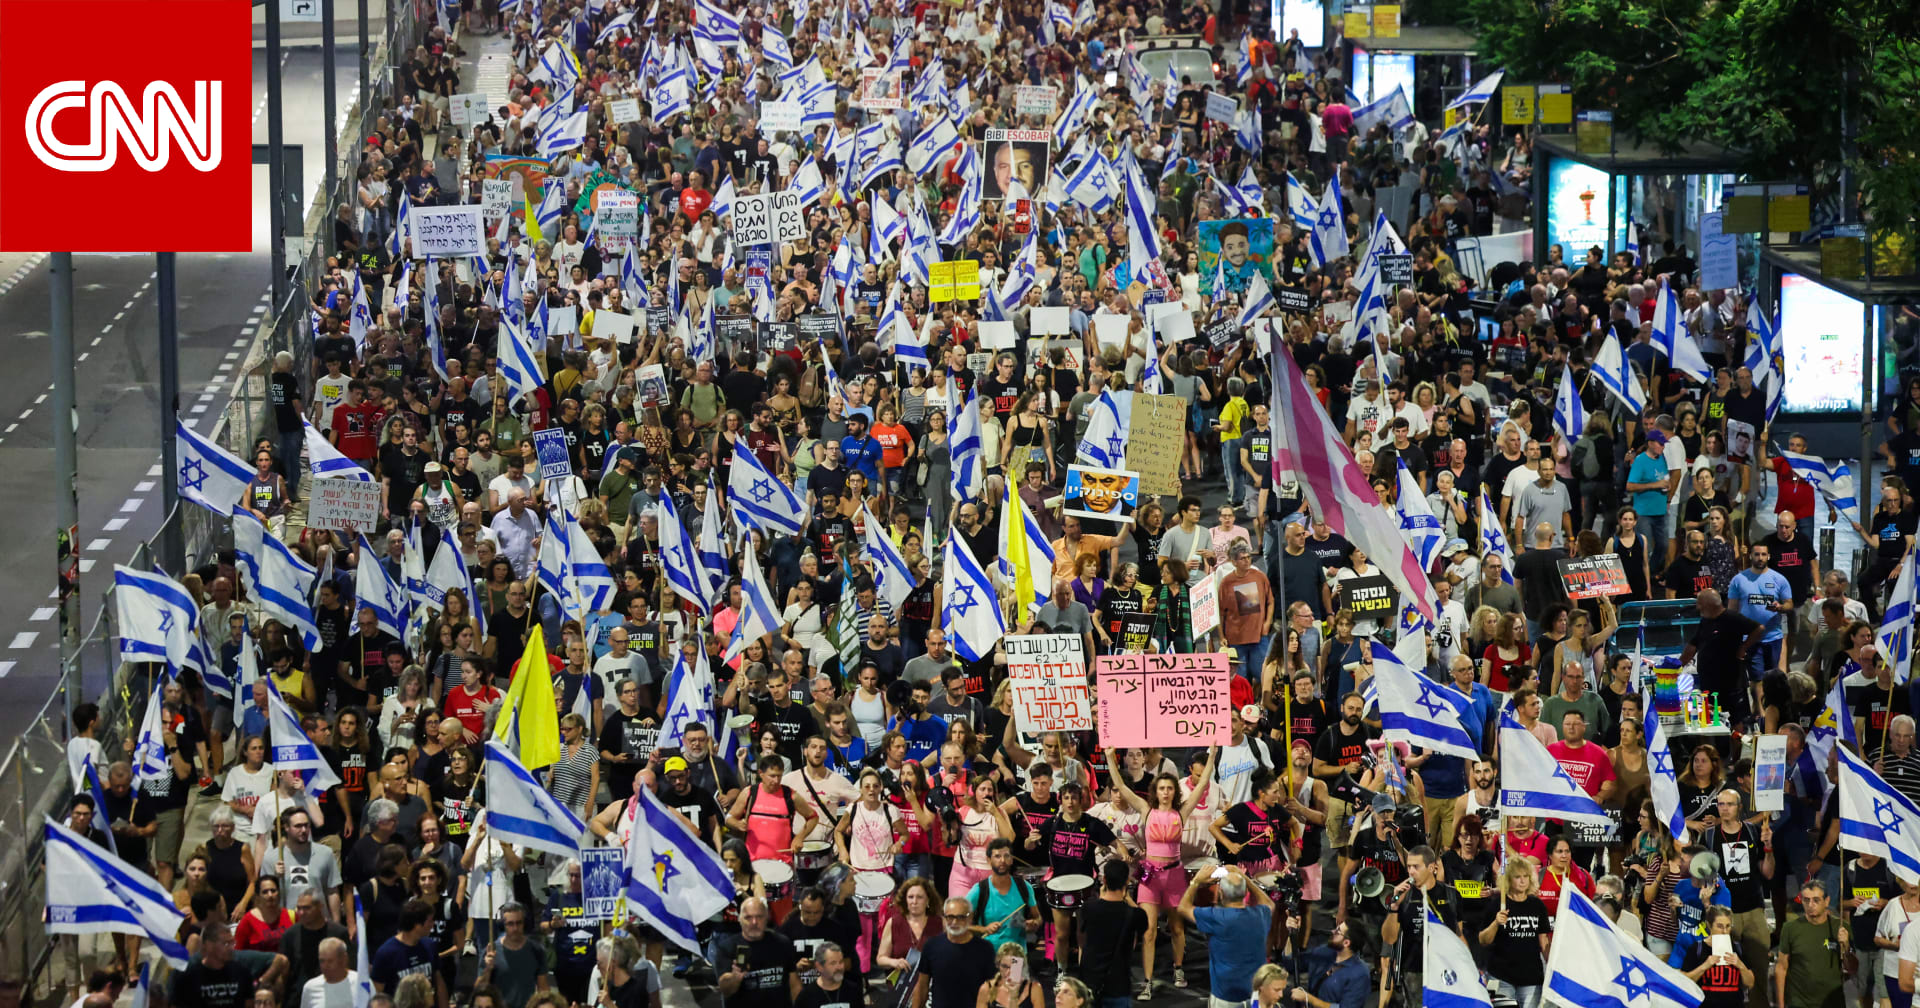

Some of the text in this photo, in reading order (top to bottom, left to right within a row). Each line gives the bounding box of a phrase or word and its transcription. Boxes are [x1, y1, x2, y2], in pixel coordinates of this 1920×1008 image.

[986, 130, 1050, 142] BIBI ESCOBAR
[439, 213, 467, 224] ויאמר
[735, 212, 798, 232] גם מתים
[736, 225, 801, 246] וגם סובלים
[769, 324, 787, 332] חיים
[766, 339, 785, 349] Life
[447, 413, 465, 422] FCK
[534, 432, 563, 442] בחירות
[1067, 485, 1136, 501] ספינוקיו
[1314, 549, 1340, 557] Wharton
[1351, 585, 1387, 601] עסקה
[1351, 597, 1392, 613] עכשיו!
[1126, 622, 1150, 635] עסקה
[1006, 635, 1081, 655] כולנו שבויים
[1035, 654, 1050, 664] 62
[1101, 658, 1140, 671] בעד
[1148, 656, 1177, 670] נגד
[1043, 662, 1086, 679] עבדים
[1042, 676, 1056, 687] של
[1151, 676, 1195, 693] הבטחון
[1197, 675, 1216, 686] שר
[1060, 685, 1089, 702] רודן
[1170, 689, 1217, 704] הבטחון
[1025, 701, 1079, 724] מסוכן
[1033, 717, 1092, 731] ולא כשיר
[640, 745, 656, 753] STO
[640, 752, 652, 760] TH
[1583, 828, 1605, 837] STOP
[582, 850, 622, 862] בחירות
